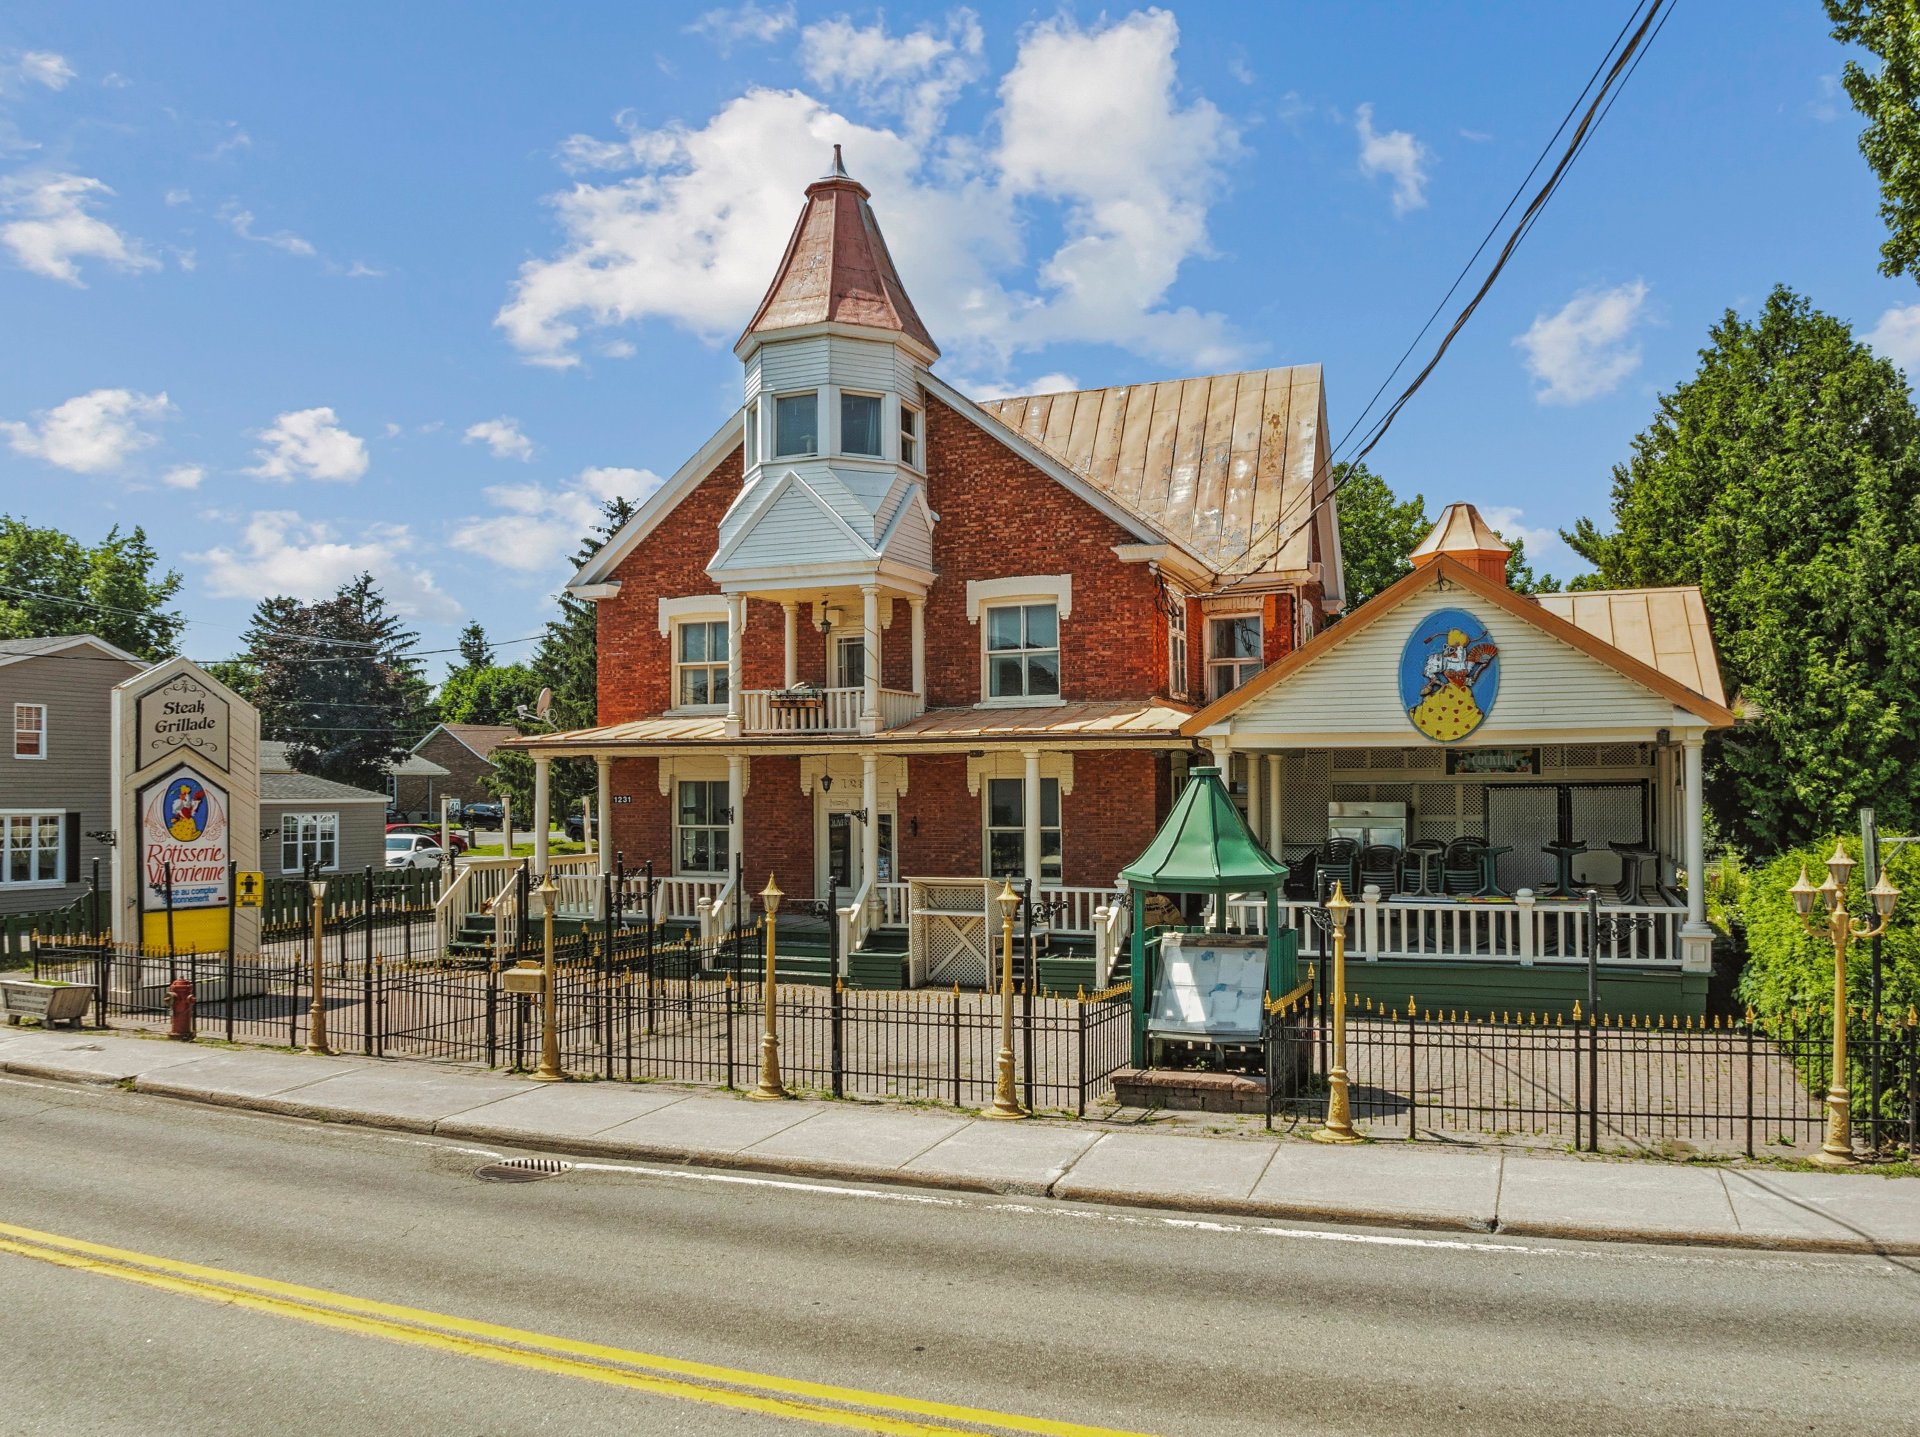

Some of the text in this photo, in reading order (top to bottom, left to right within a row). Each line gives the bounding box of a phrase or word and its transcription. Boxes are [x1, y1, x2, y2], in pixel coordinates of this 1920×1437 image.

[163, 700, 205, 715] Steak
[155, 717, 216, 733] Grillade
[1472, 755, 1515, 766] COCKTAIL
[147, 844, 226, 866] Rôtisserie
[191, 886, 218, 895] comptoir
